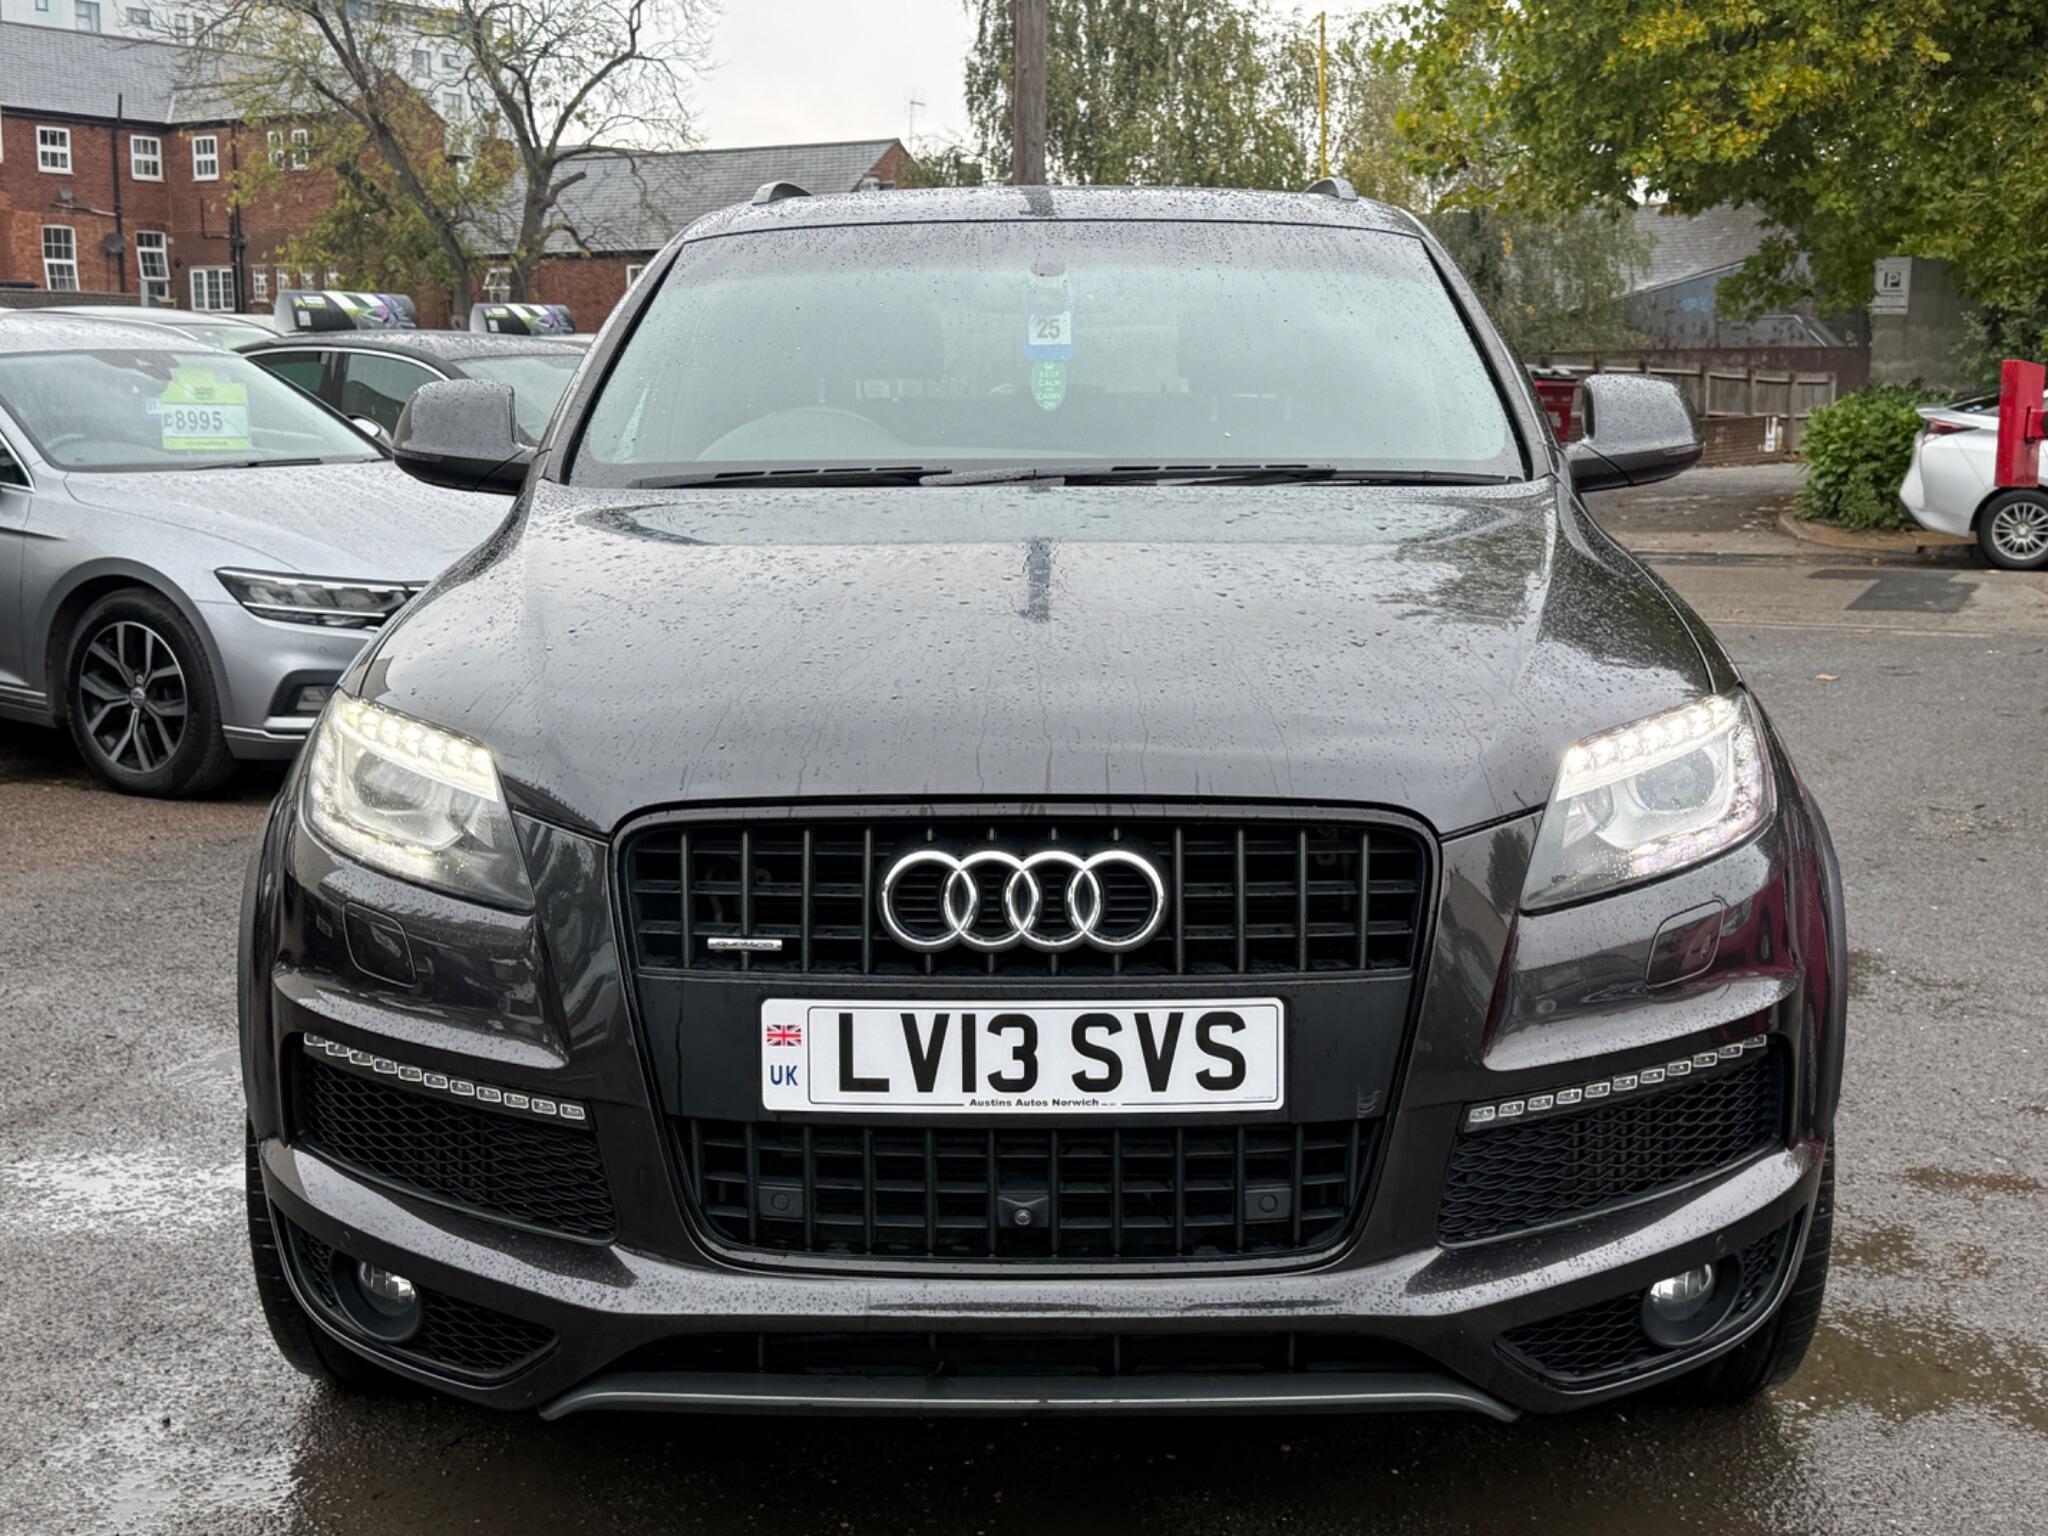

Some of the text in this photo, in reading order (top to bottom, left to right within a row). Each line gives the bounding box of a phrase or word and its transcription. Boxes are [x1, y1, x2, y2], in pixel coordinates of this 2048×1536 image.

[1036, 318, 1061, 339] 25
[838, 1011, 1246, 1093] LV13 SVS
[769, 1064, 799, 1086] UK
[968, 1097, 1012, 1107] Austins
[1015, 1097, 1048, 1107] Autos
[1052, 1097, 1099, 1107] Norwich
